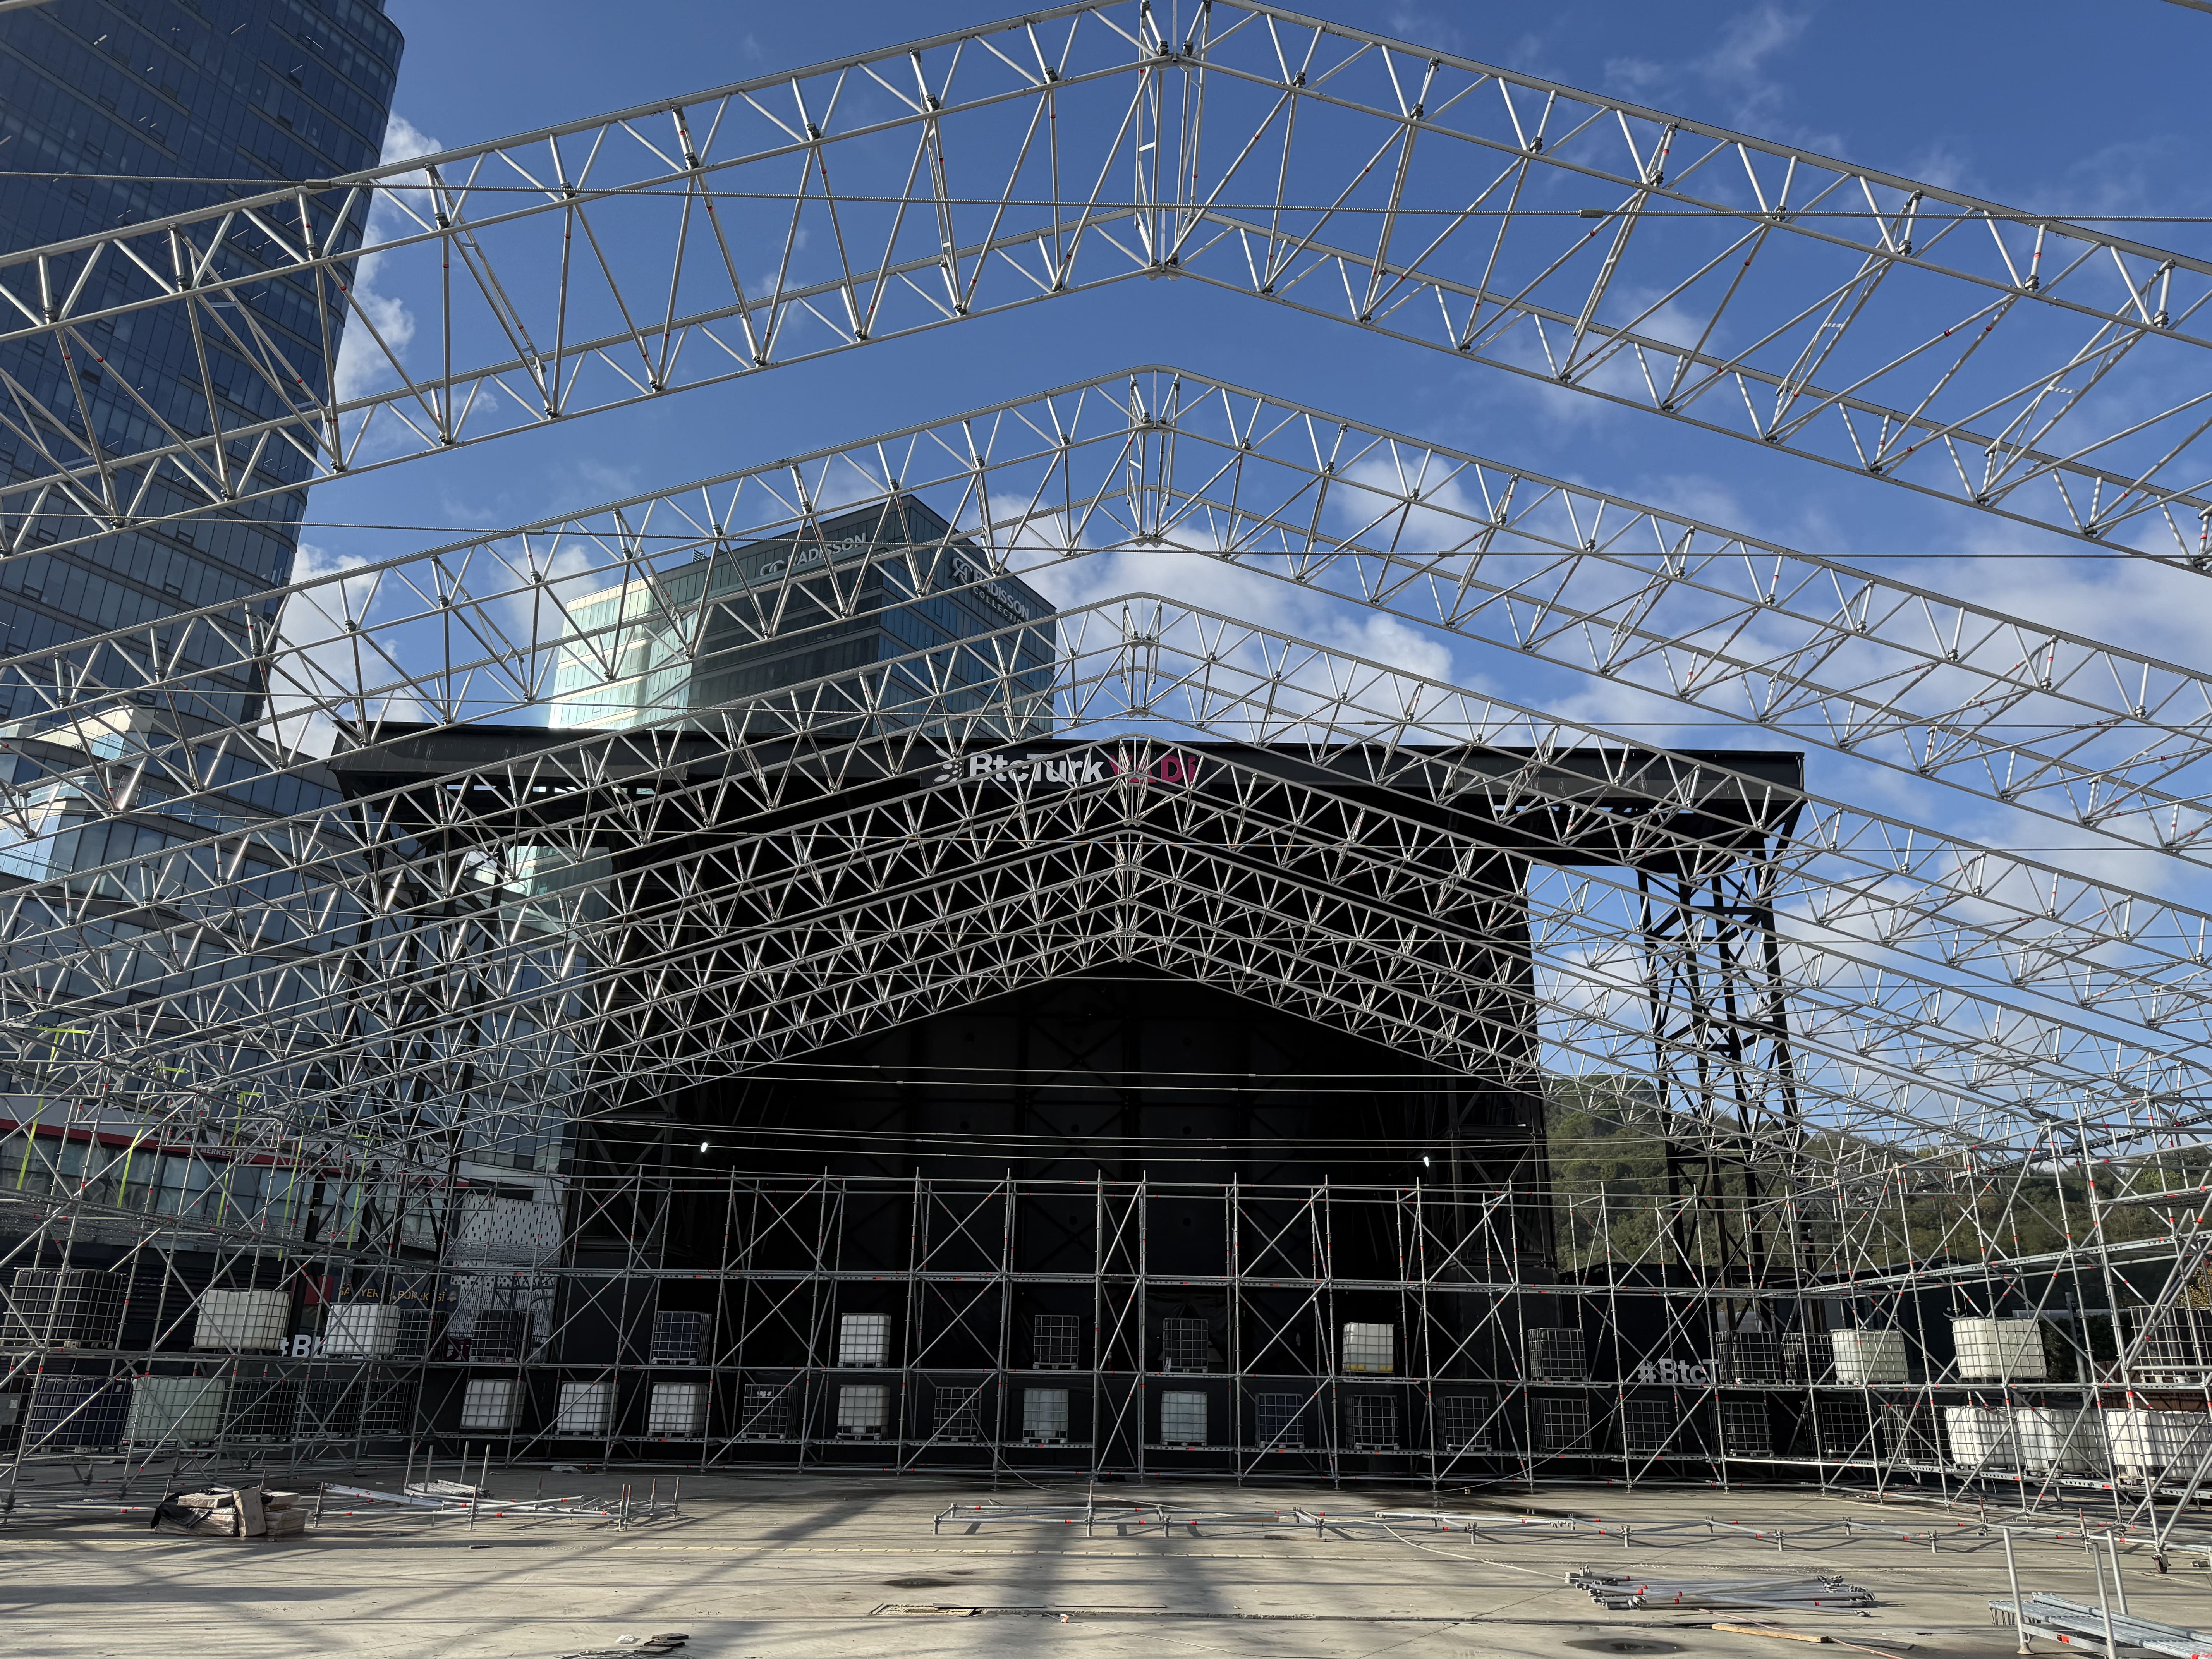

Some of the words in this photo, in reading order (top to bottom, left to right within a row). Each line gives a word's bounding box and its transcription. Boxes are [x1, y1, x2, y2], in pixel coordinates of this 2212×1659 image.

[973, 587, 1028, 631] COLLECTIO
[974, 569, 1029, 621] RADISSON
[969, 752, 1104, 783] BtcTurk
[200, 1148, 231, 1157] MERKEZ
